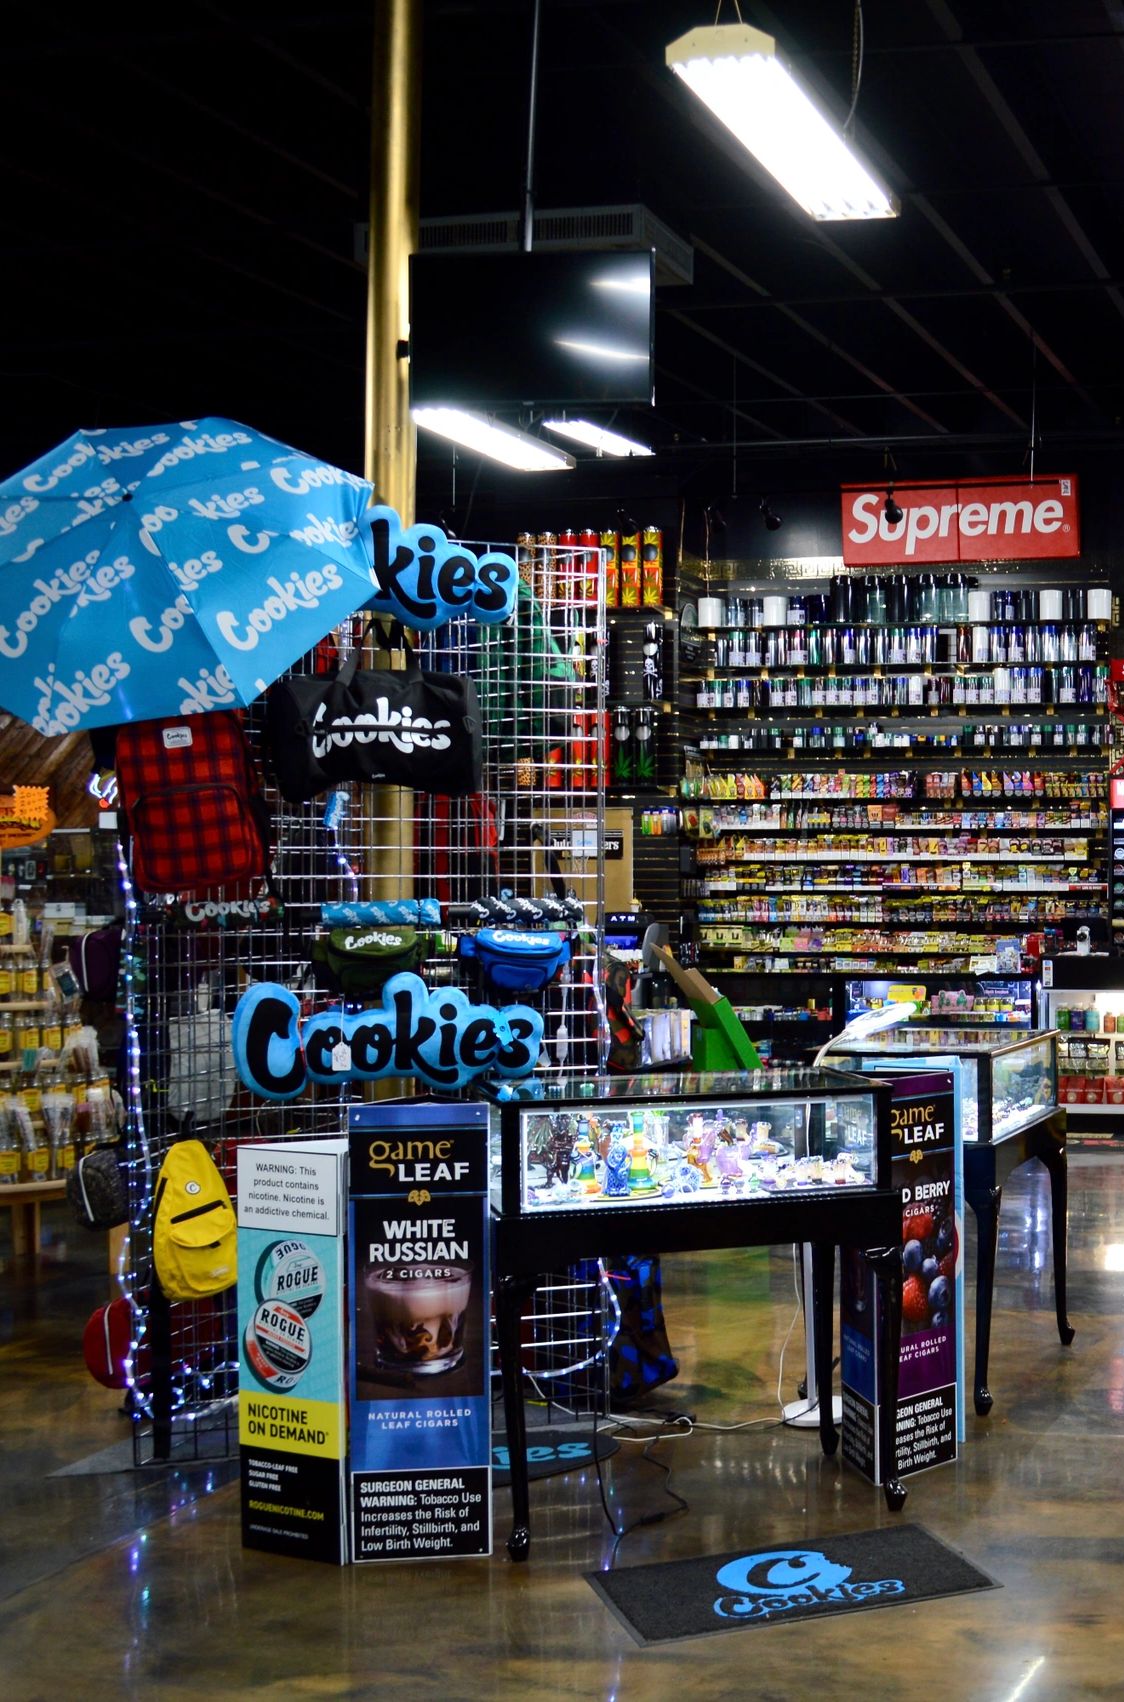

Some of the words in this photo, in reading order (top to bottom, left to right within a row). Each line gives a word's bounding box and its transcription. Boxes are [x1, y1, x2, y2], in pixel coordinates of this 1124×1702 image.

[147, 432, 252, 477] ookies
[188, 487, 264, 520] kies
[848, 494, 1064, 556] Supreme
[371, 519, 513, 619] kies
[216, 563, 343, 651] Cookies
[313, 697, 450, 758] Cookies
[185, 900, 271, 922] Cookies
[345, 931, 403, 950] Cookies
[492, 930, 551, 945] Cookies
[246, 990, 534, 1093] Cookies
[904, 1123, 944, 1144] LEAF
[368, 1139, 453, 1177] game
[256, 1163, 297, 1174] WARNING:
[299, 1166, 317, 1176] This
[398, 1161, 469, 1182] LEAF
[253, 1178, 283, 1188] product
[285, 1181, 319, 1190] contains
[915, 1180, 950, 1200] BERRY
[248, 1191, 281, 1202] nicotine.
[283, 1193, 315, 1205] Nicotine
[317, 1196, 325, 1205] is
[255, 1205, 290, 1217] addictive
[292, 1208, 330, 1220] chemical.
[905, 1206, 935, 1217] CIGARS
[383, 1219, 455, 1239] WHITE
[369, 1240, 469, 1262] RUSSIAN
[277, 1266, 319, 1292] ROGUE
[386, 1270, 394, 1279] 2
[400, 1268, 451, 1279] CIGARS
[260, 1308, 306, 1342] ROGUE
[900, 1344, 919, 1354] URAL
[921, 1335, 947, 1348] ROLLED
[899, 1354, 912, 1363] EAF
[914, 1346, 939, 1359] CIGARS
[248, 1403, 308, 1424] NICOTINE
[368, 1409, 422, 1420] NATURAL
[426, 1408, 472, 1418] ROLLED
[914, 1396, 943, 1413] GENERAL
[248, 1420, 266, 1436] ON
[381, 1421, 411, 1430] LEAF
[415, 1419, 458, 1429] CIGARS
[896, 1417, 916, 1432] NING:
[917, 1410, 940, 1426] Tobacco
[941, 1407, 952, 1419] Use
[896, 1431, 914, 1445] eases
[914, 1427, 925, 1439] the
[926, 1423, 938, 1436] Risk
[940, 1420, 946, 1432] of
[940, 1431, 951, 1443] and
[248, 1459, 285, 1472] TOBACCO-LEAF
[285, 1465, 298, 1474] FREE
[897, 1458, 913, 1470] Birth
[248, 1469, 265, 1478] SUGAR
[266, 1472, 279, 1481] FREE
[249, 1480, 268, 1489] GLUTEN
[269, 1484, 281, 1492] FREE
[360, 1480, 412, 1493] SURGEON
[415, 1478, 465, 1491] GENERAL
[360, 1494, 417, 1508] WARNING:
[420, 1493, 459, 1505] Tobacco
[461, 1492, 482, 1503] Use
[249, 1500, 324, 1521] ROGUENICOTINE.COM
[361, 1510, 413, 1522] Increases
[415, 1509, 432, 1519] the
[434, 1507, 456, 1519] Risk
[458, 1506, 470, 1518] of
[361, 1524, 410, 1537] Infertility,
[412, 1522, 458, 1535] Stillbirth,
[460, 1520, 480, 1532] and
[361, 1541, 383, 1551] Low
[386, 1538, 410, 1550] Birth
[413, 1537, 453, 1550] Weight.
[713, 1579, 906, 1619] Cookies
